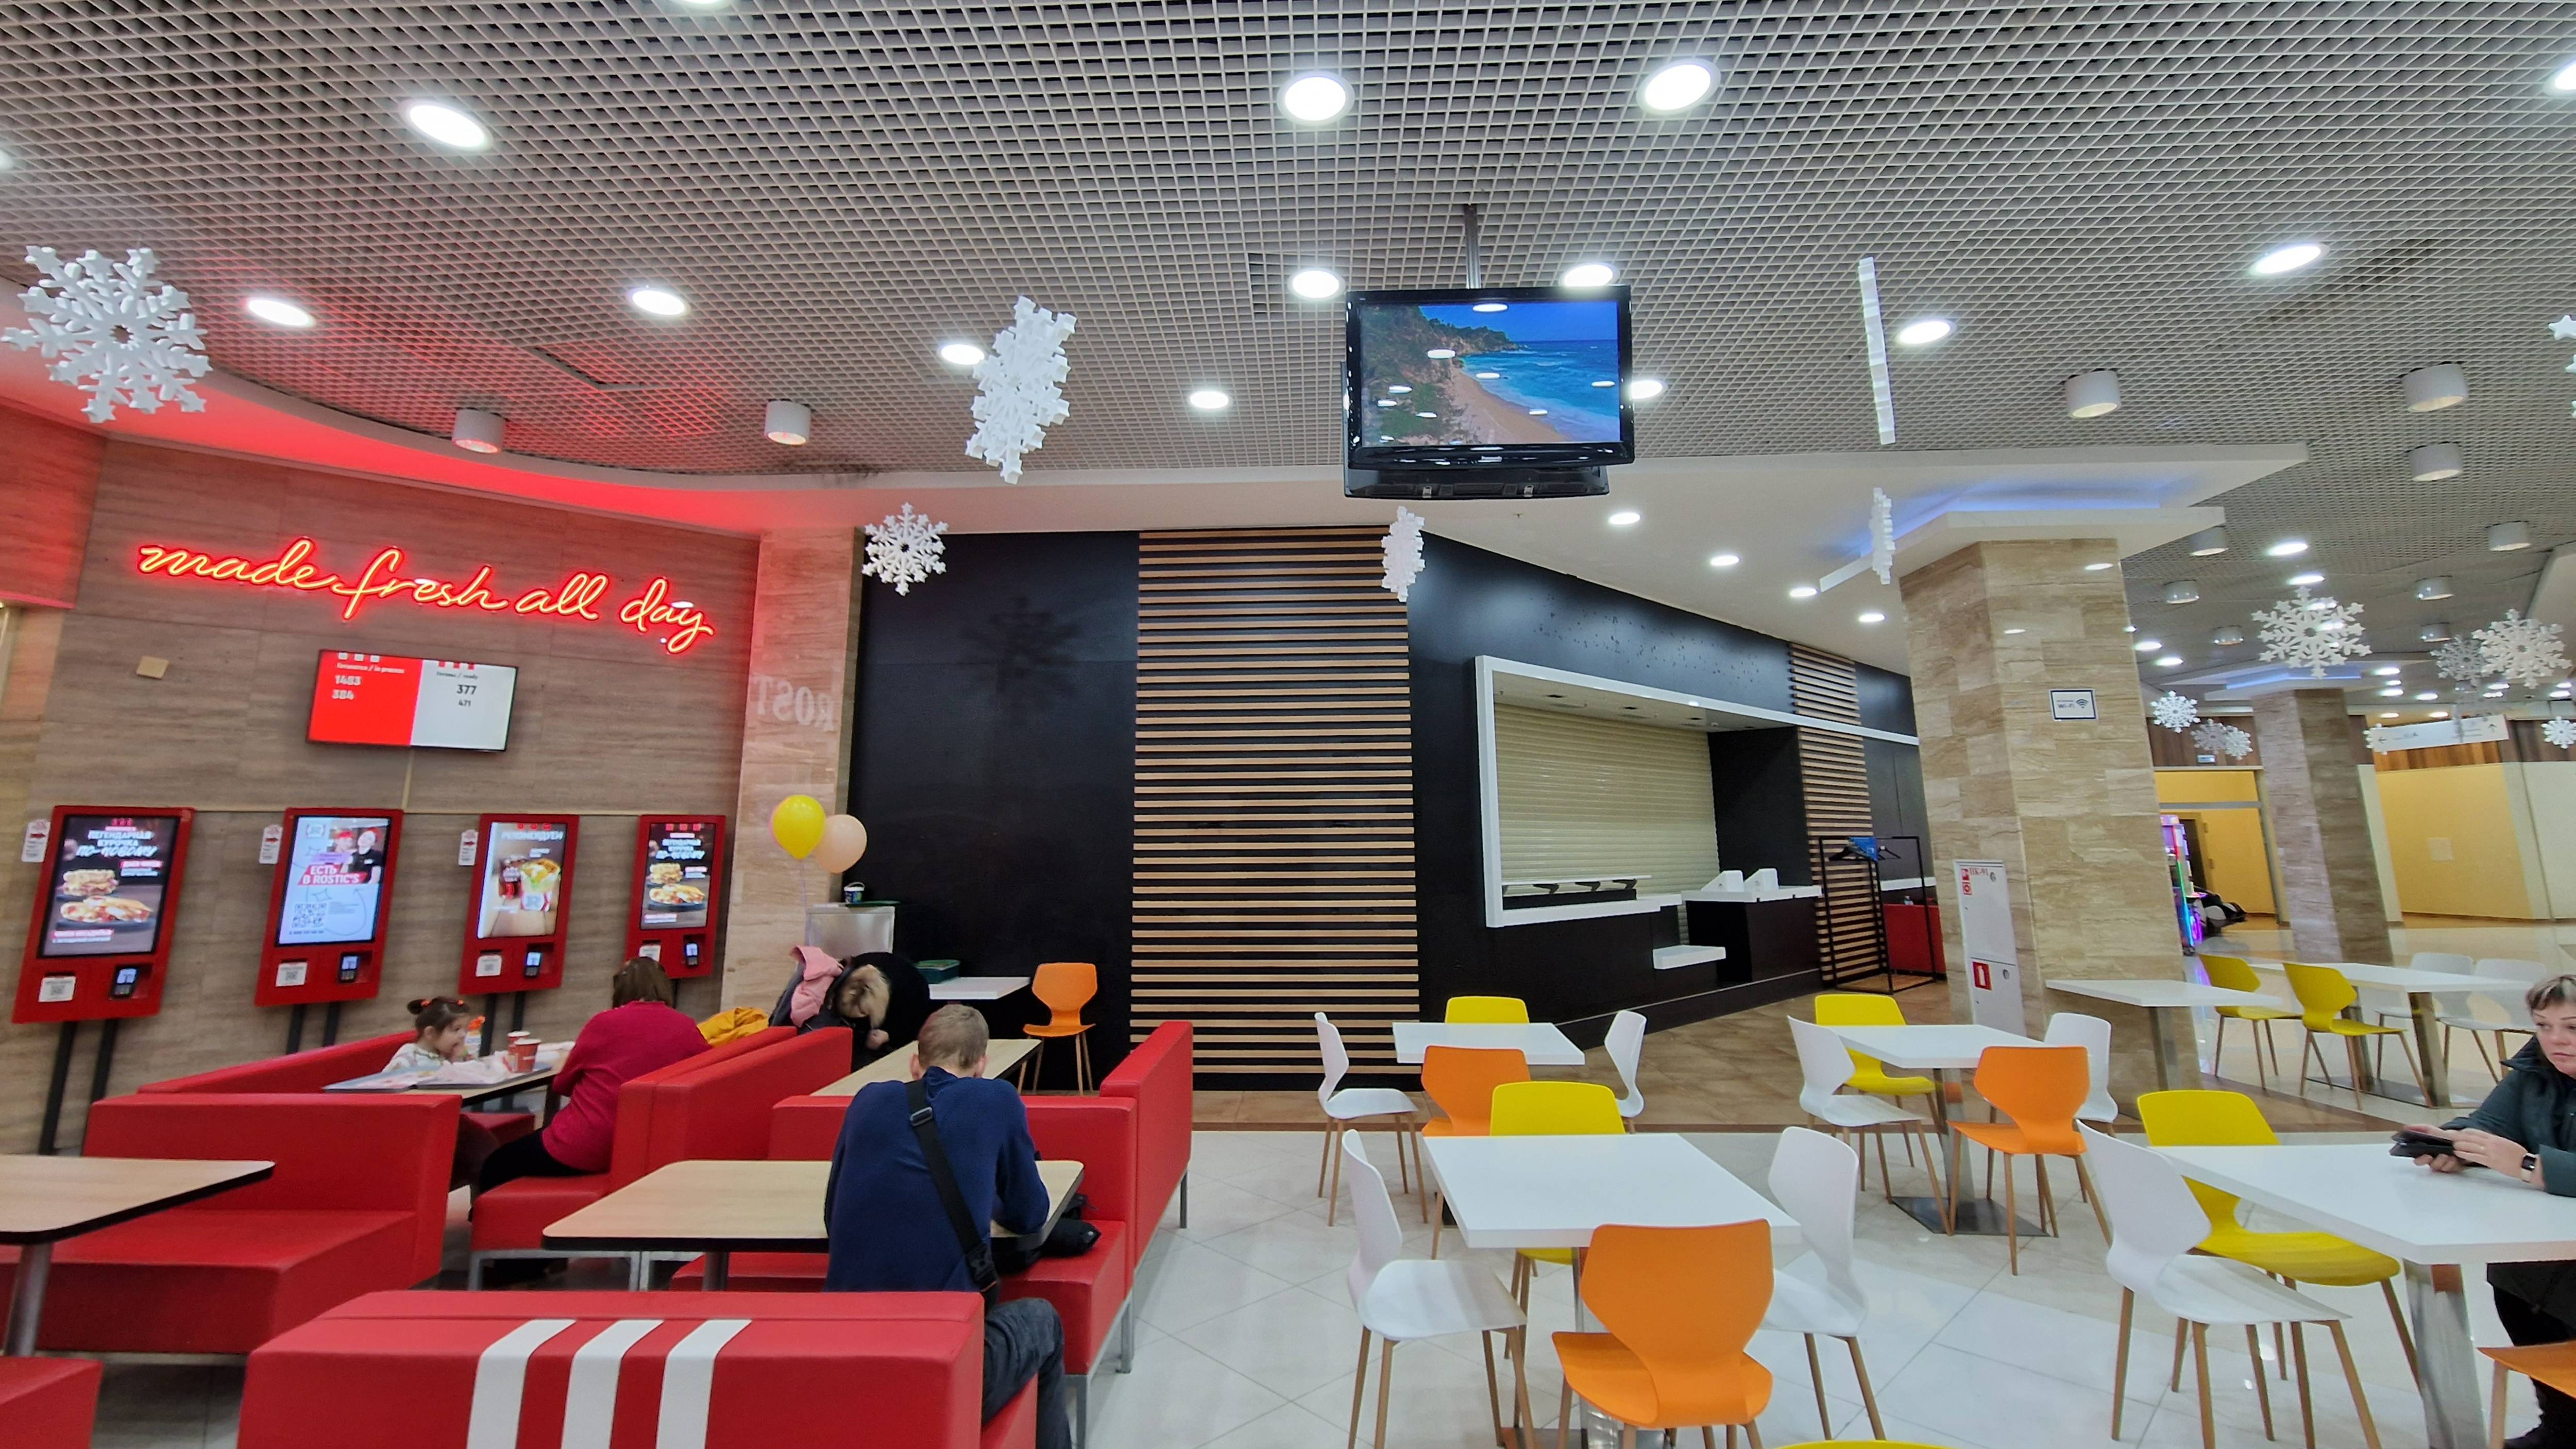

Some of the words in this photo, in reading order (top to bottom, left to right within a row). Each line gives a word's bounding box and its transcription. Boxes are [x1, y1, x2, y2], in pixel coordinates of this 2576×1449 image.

[139, 537, 337, 591] made
[331, 547, 509, 619] fresh
[515, 572, 608, 620] all
[619, 578, 715, 653] day
[456, 684, 477, 695] 377
[310, 865, 337, 875] ЕСТЬ
[302, 874, 311, 884] В
[312, 872, 360, 884] ROSTIC'S
